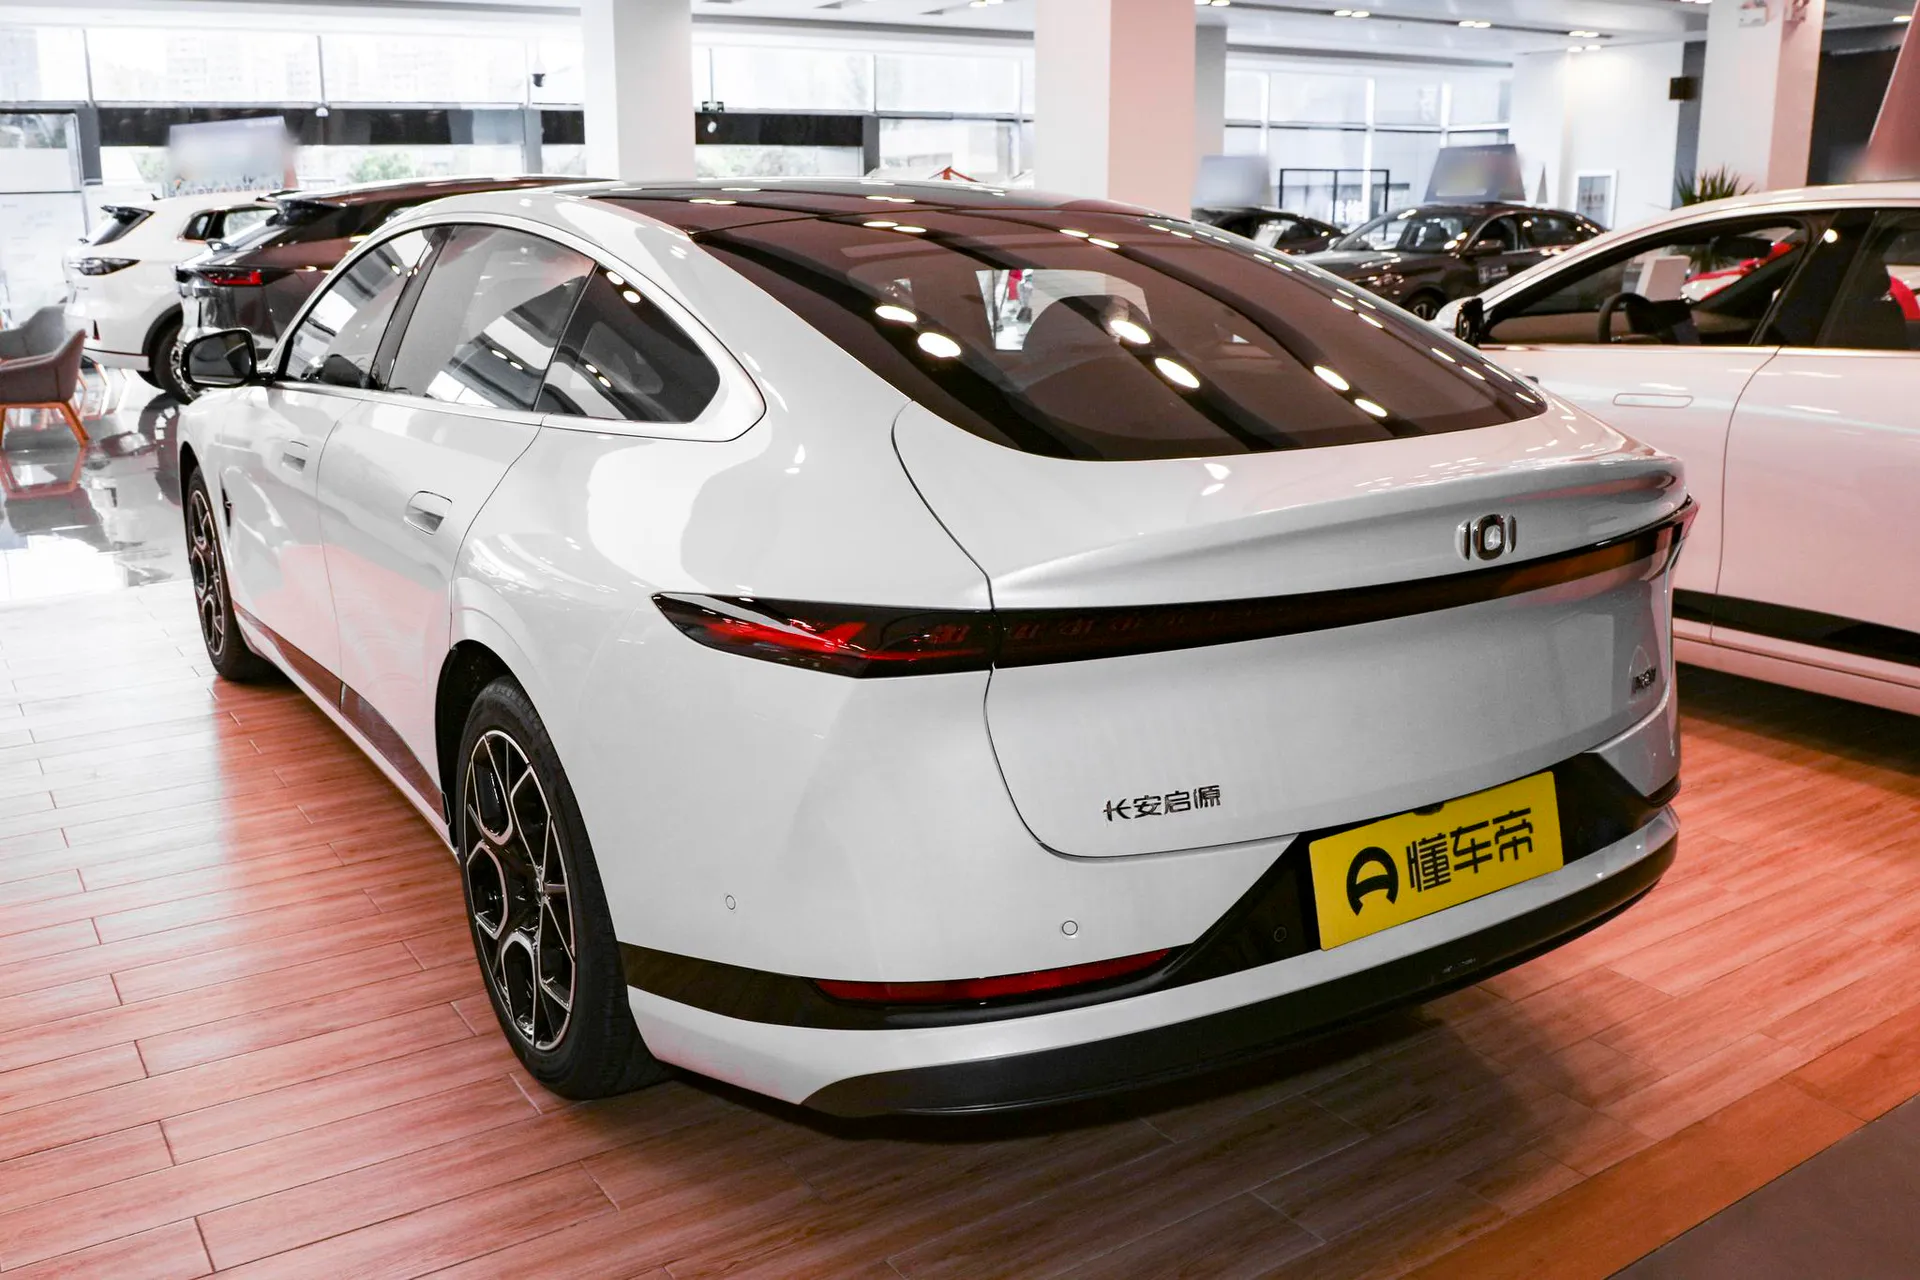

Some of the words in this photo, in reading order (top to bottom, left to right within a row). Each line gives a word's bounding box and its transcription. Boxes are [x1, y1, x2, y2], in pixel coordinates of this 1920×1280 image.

[1103, 785, 1221, 821] 长安启源
[1406, 807, 1534, 892] 懂车帝
